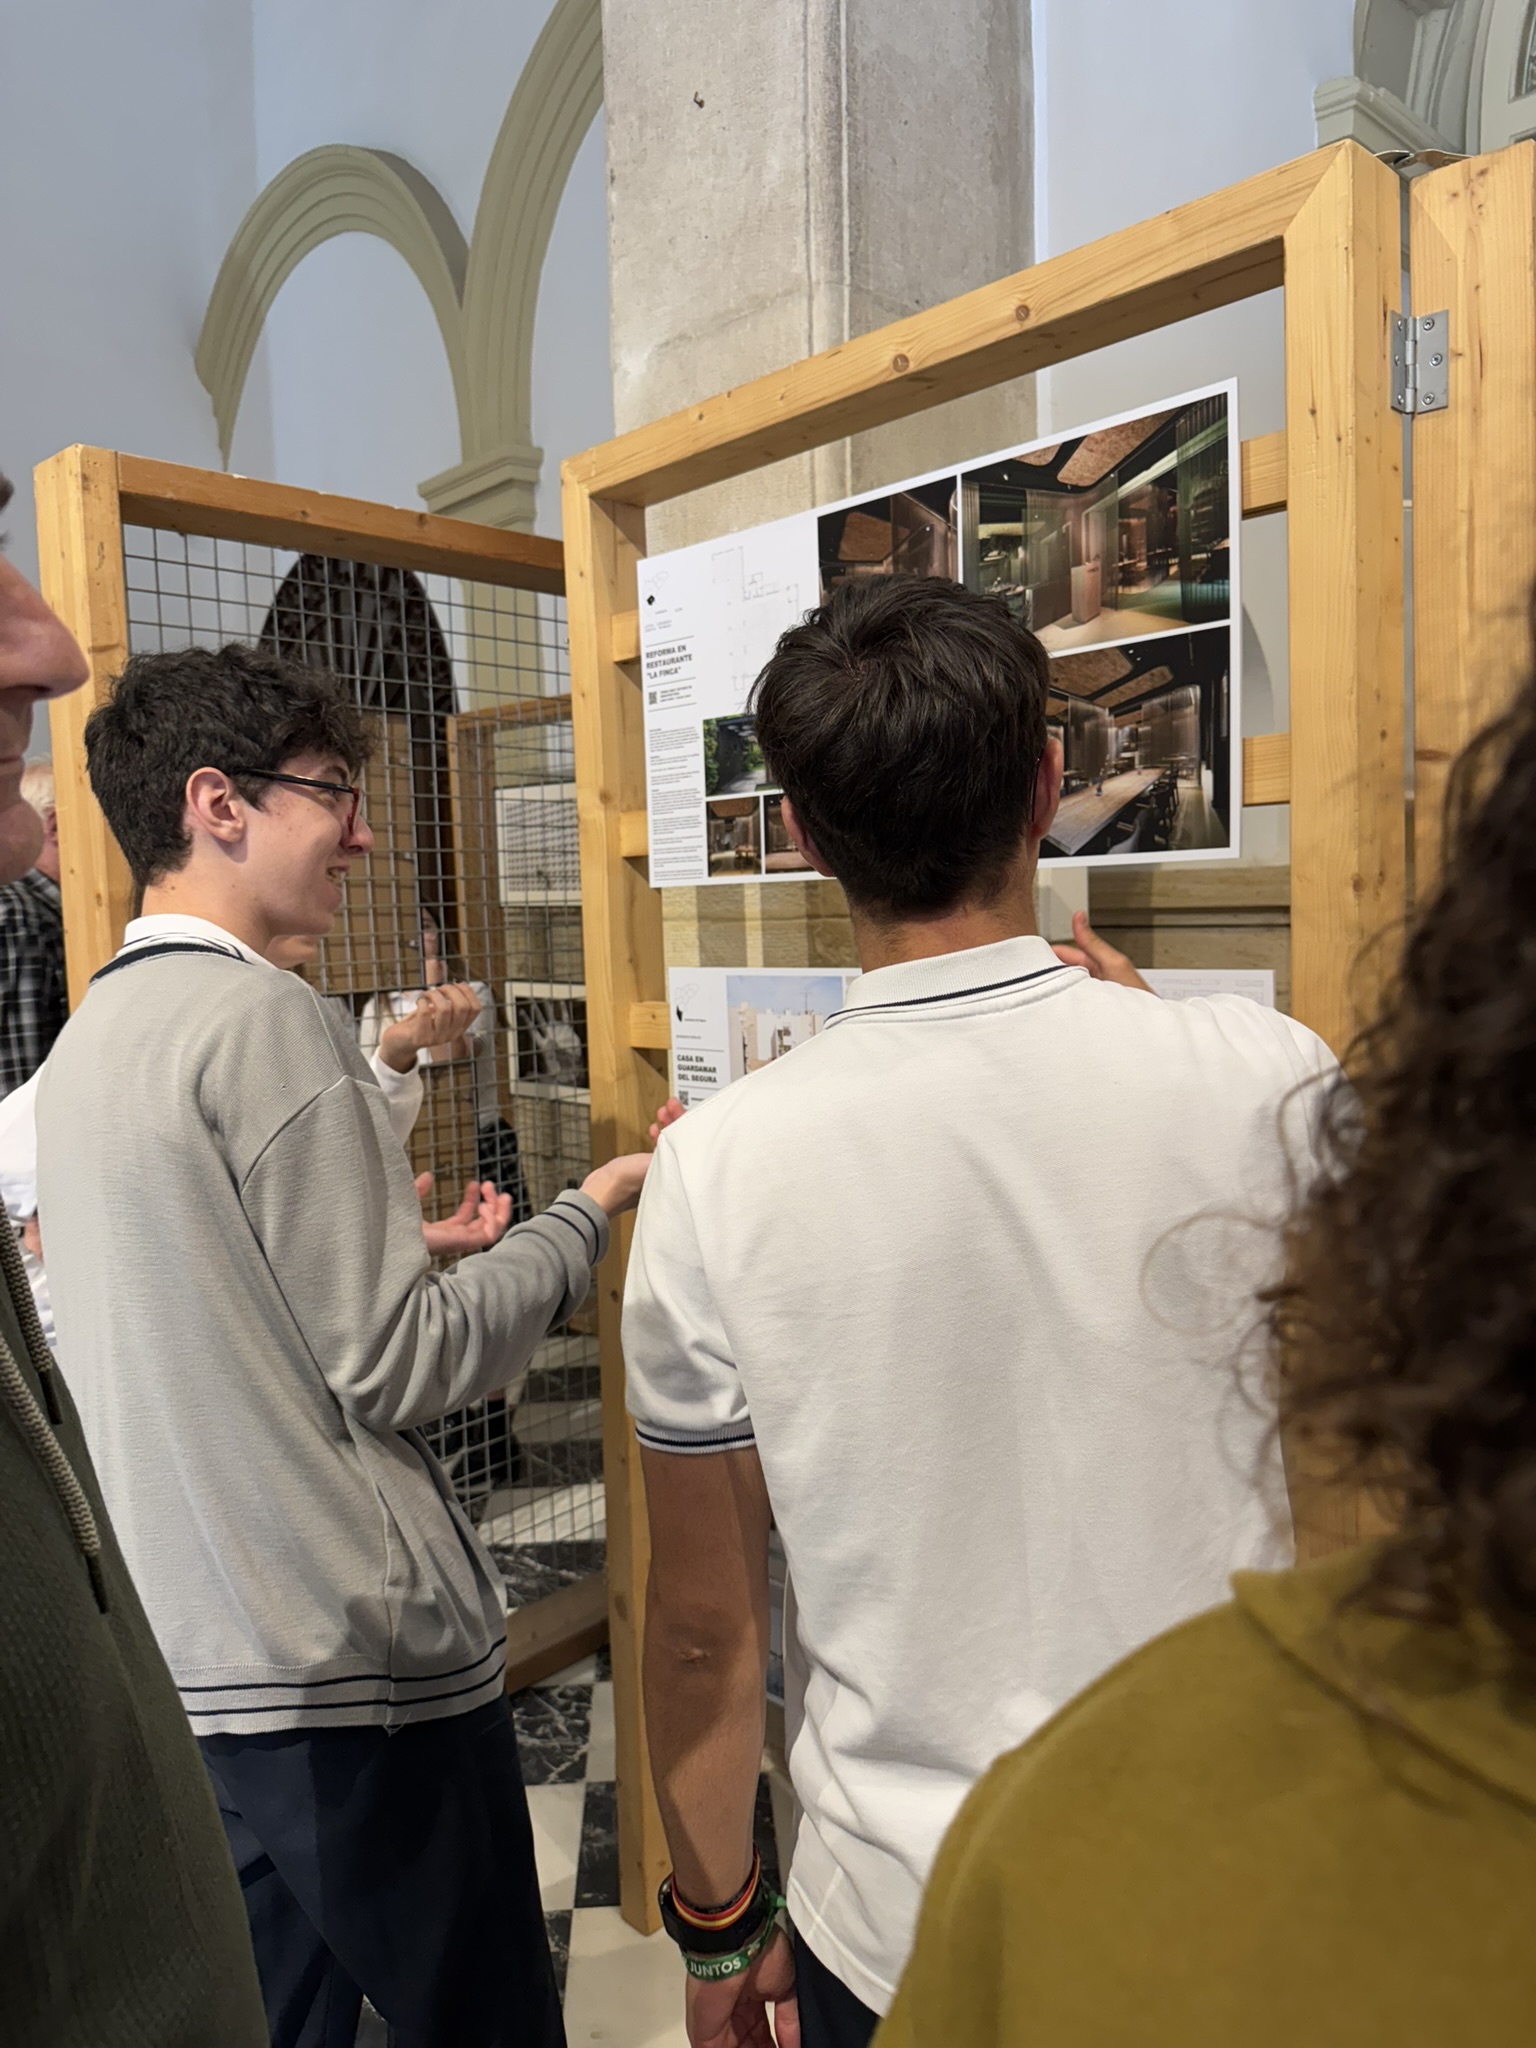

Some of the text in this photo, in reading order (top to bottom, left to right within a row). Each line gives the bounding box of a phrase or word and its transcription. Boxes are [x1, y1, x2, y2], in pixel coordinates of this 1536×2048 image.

[646, 645, 686, 659] REFORMA EN
[646, 654, 692, 669] RESTAURANTE
[677, 1064, 717, 1073] GUARDAMAR
[678, 1073, 717, 1083] DEL SEGURA
[690, 1957, 742, 1977] JUNTOS
